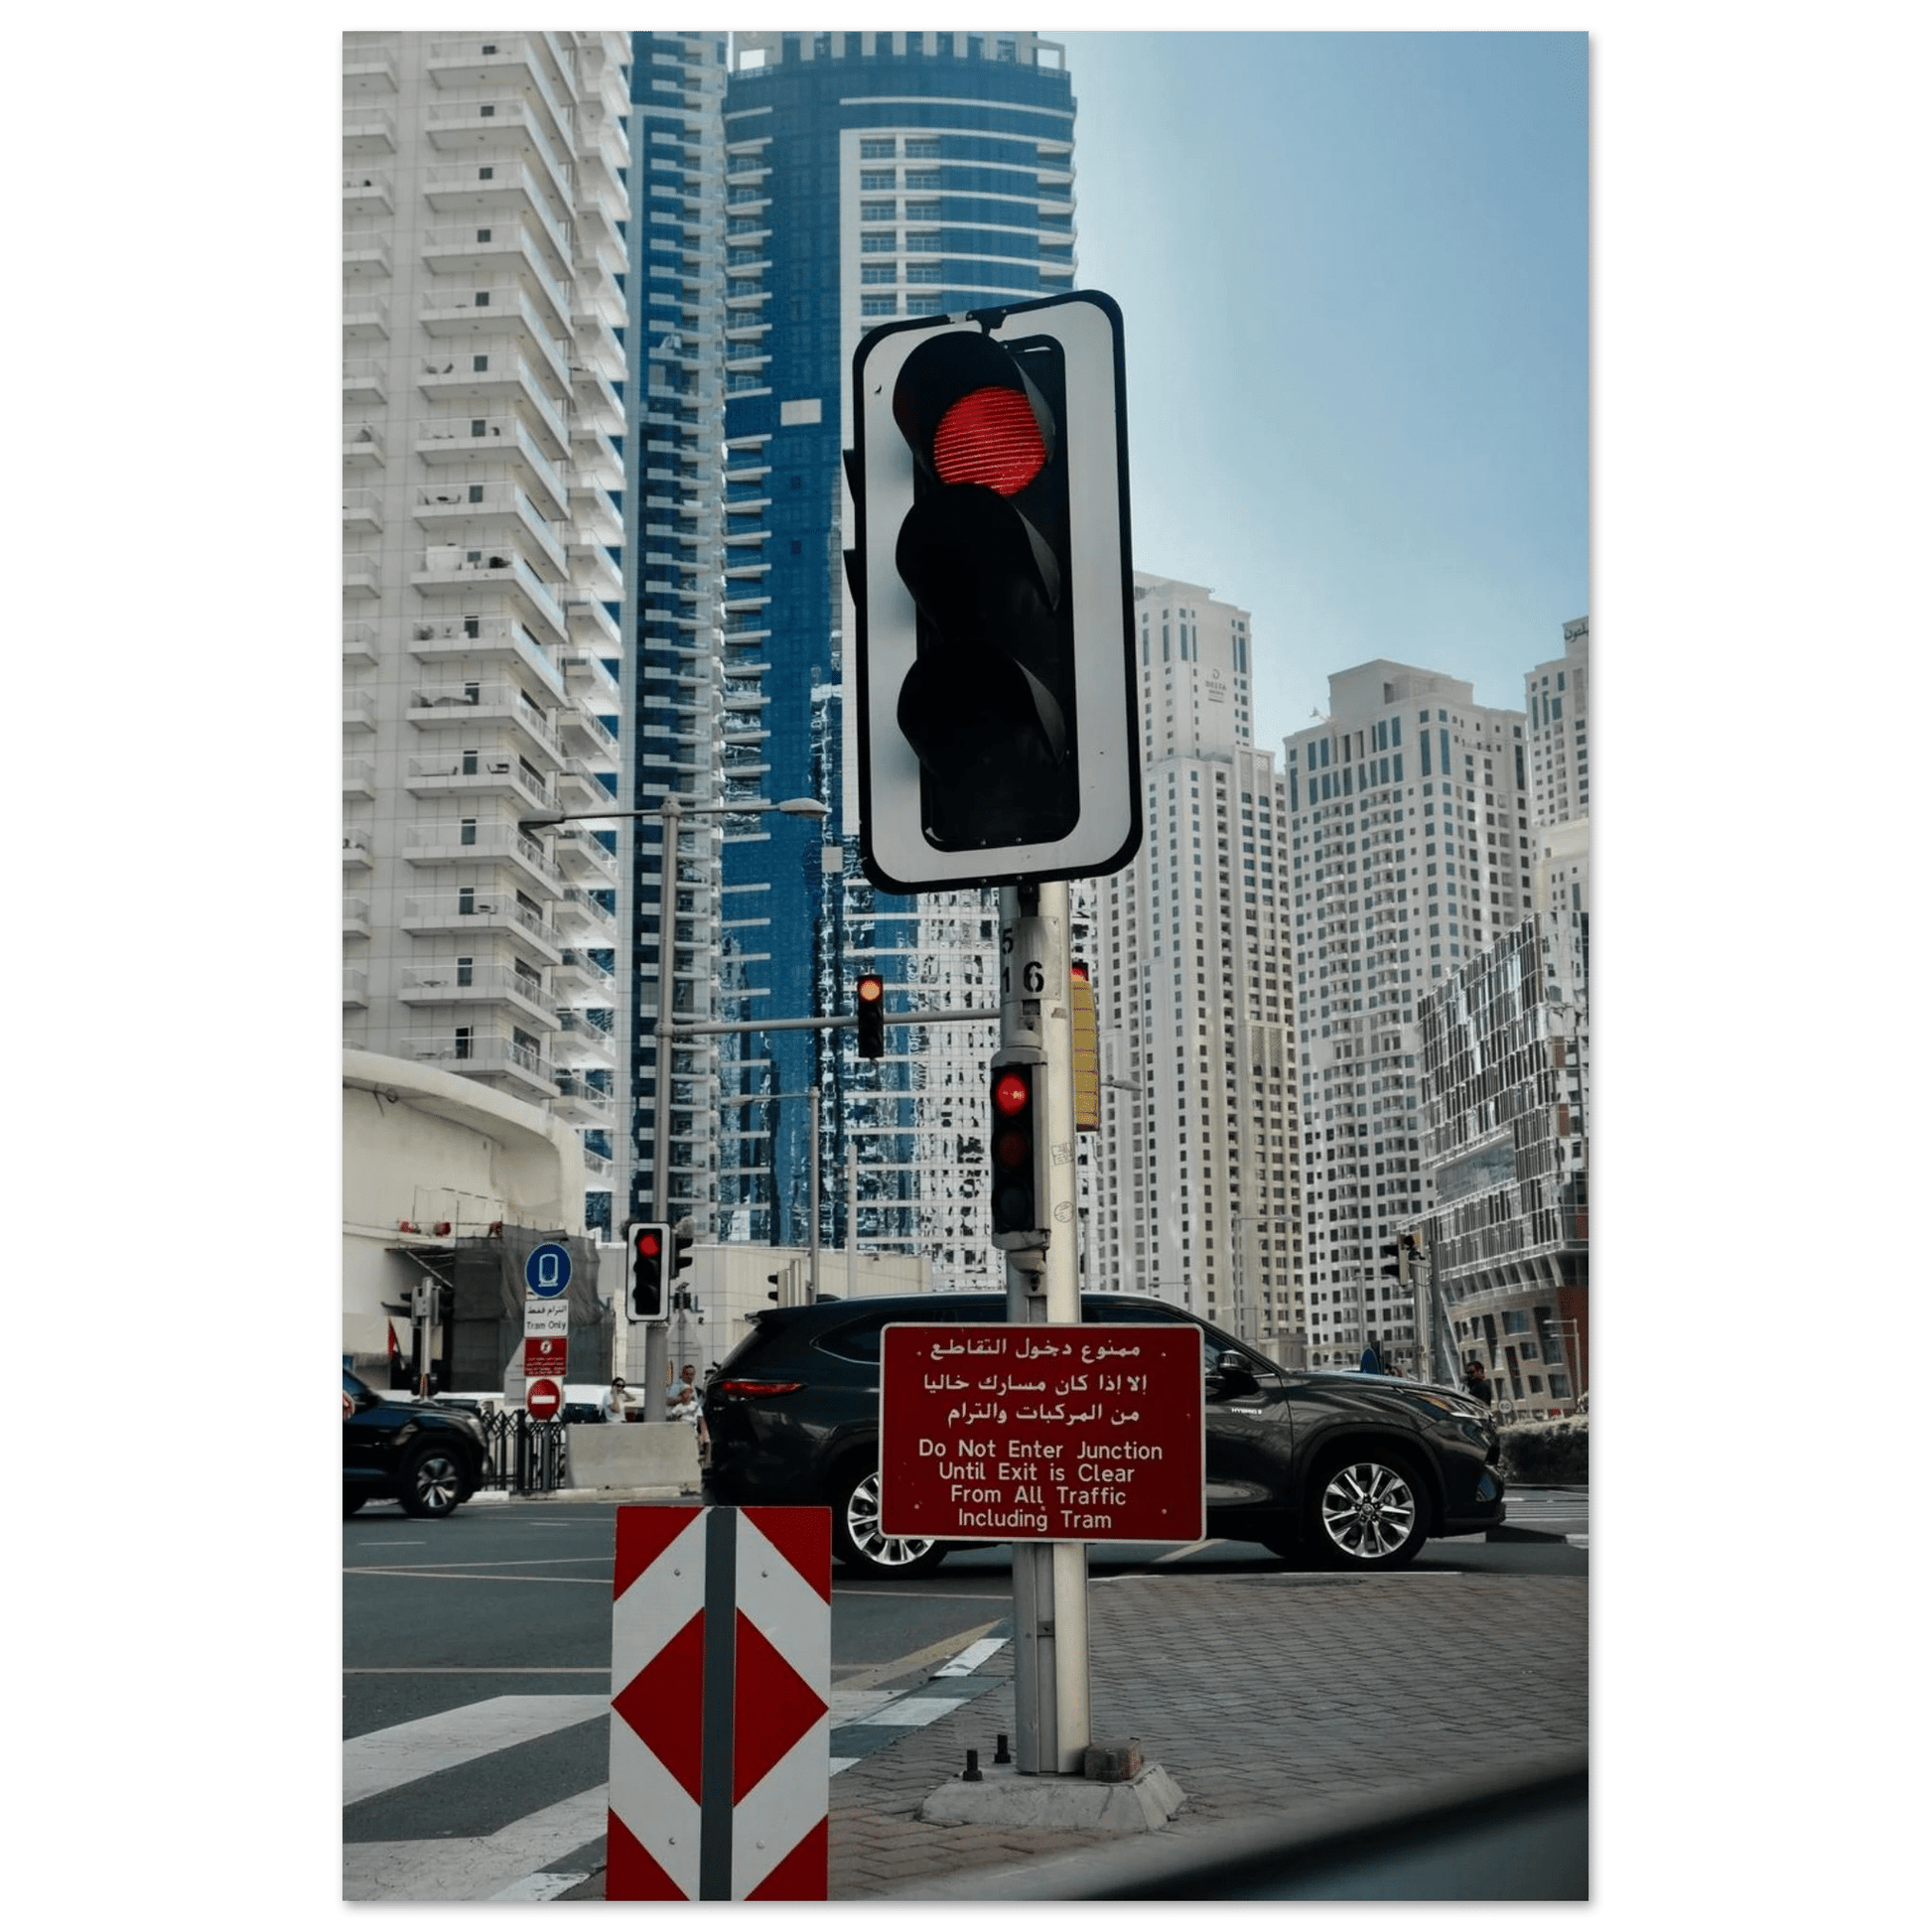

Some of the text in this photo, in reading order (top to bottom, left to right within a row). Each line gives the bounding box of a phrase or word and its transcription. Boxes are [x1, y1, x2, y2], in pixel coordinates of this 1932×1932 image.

[548, 1320, 566, 1330] Only
[930, 1337, 1141, 1364] ممنوع دخول التقاطع
[924, 1374, 970, 1394] خاليا
[978, 1374, 1046, 1396] مسارك
[1054, 1374, 1088, 1396] كان
[1099, 1374, 1121, 1395] إذا
[948, 1402, 1140, 1429] من المركبات والترام
[918, 1439, 1163, 1460] Do Not Enter Junction
[939, 1461, 1136, 1482] Until Exit is Clear
[951, 1484, 1127, 1505] From All Traffic
[958, 1508, 1112, 1532] Including Tram
